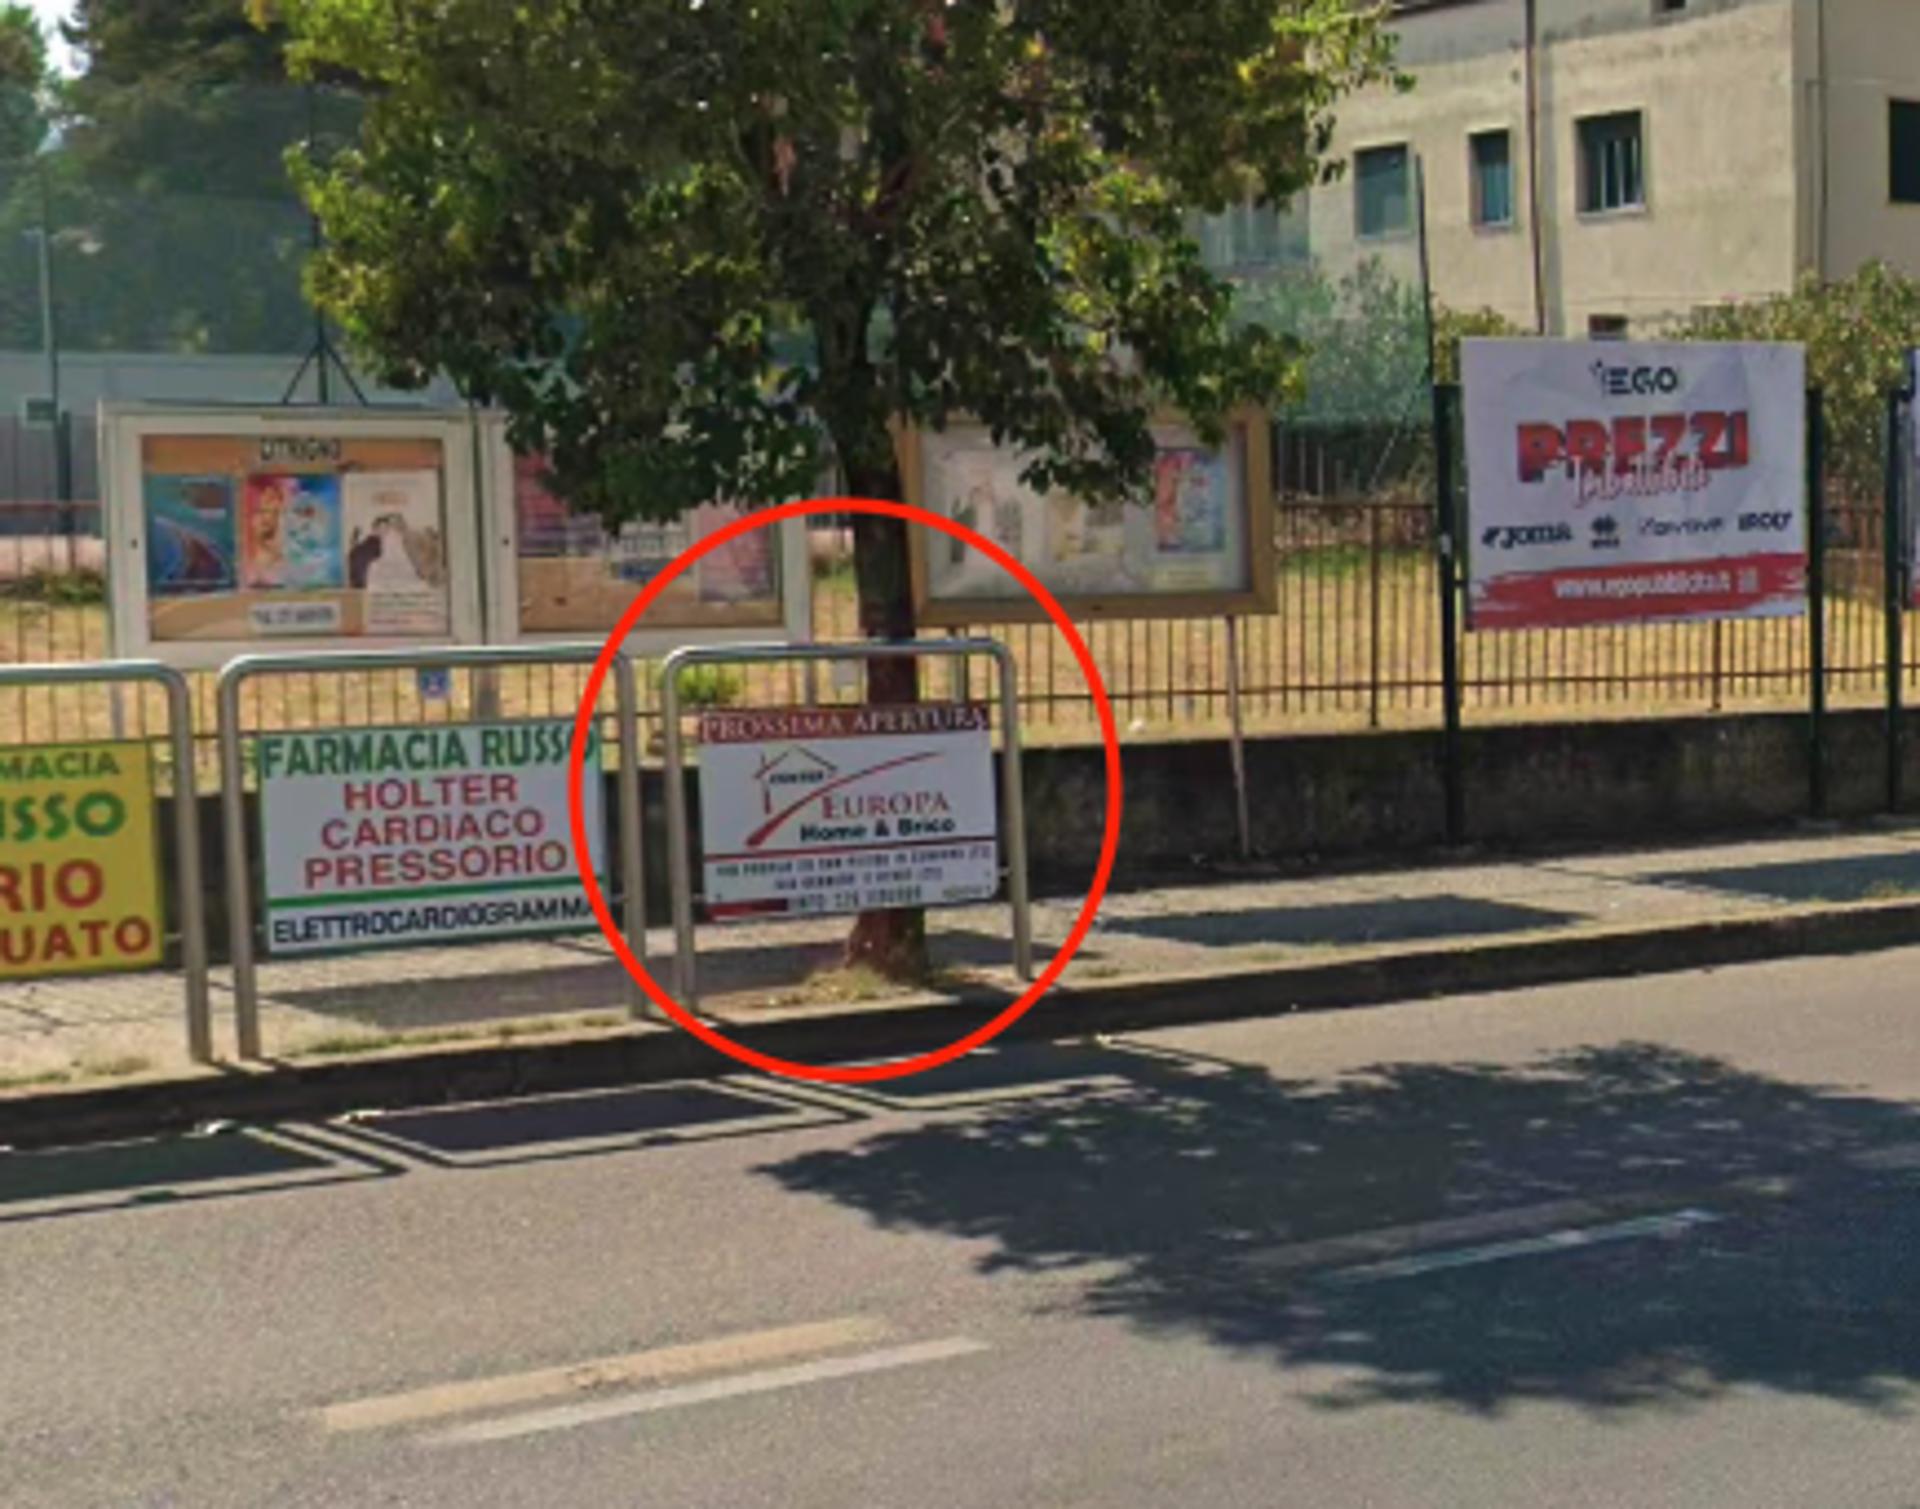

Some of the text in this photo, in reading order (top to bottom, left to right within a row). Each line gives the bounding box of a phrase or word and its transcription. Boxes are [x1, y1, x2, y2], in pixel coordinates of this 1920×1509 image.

[1517, 411, 1749, 484] PREZZI
[702, 704, 989, 742] PROSSIMA APERTURA
[262, 731, 469, 778] FARMACIA
[343, 773, 518, 811] HOLTER
[821, 790, 950, 819] EUROPA
[0, 790, 126, 843] SSO
[320, 807, 545, 851] CARDIACO
[800, 821, 868, 842] Home
[897, 816, 956, 835] Brico
[304, 840, 568, 889] PRESSORIO
